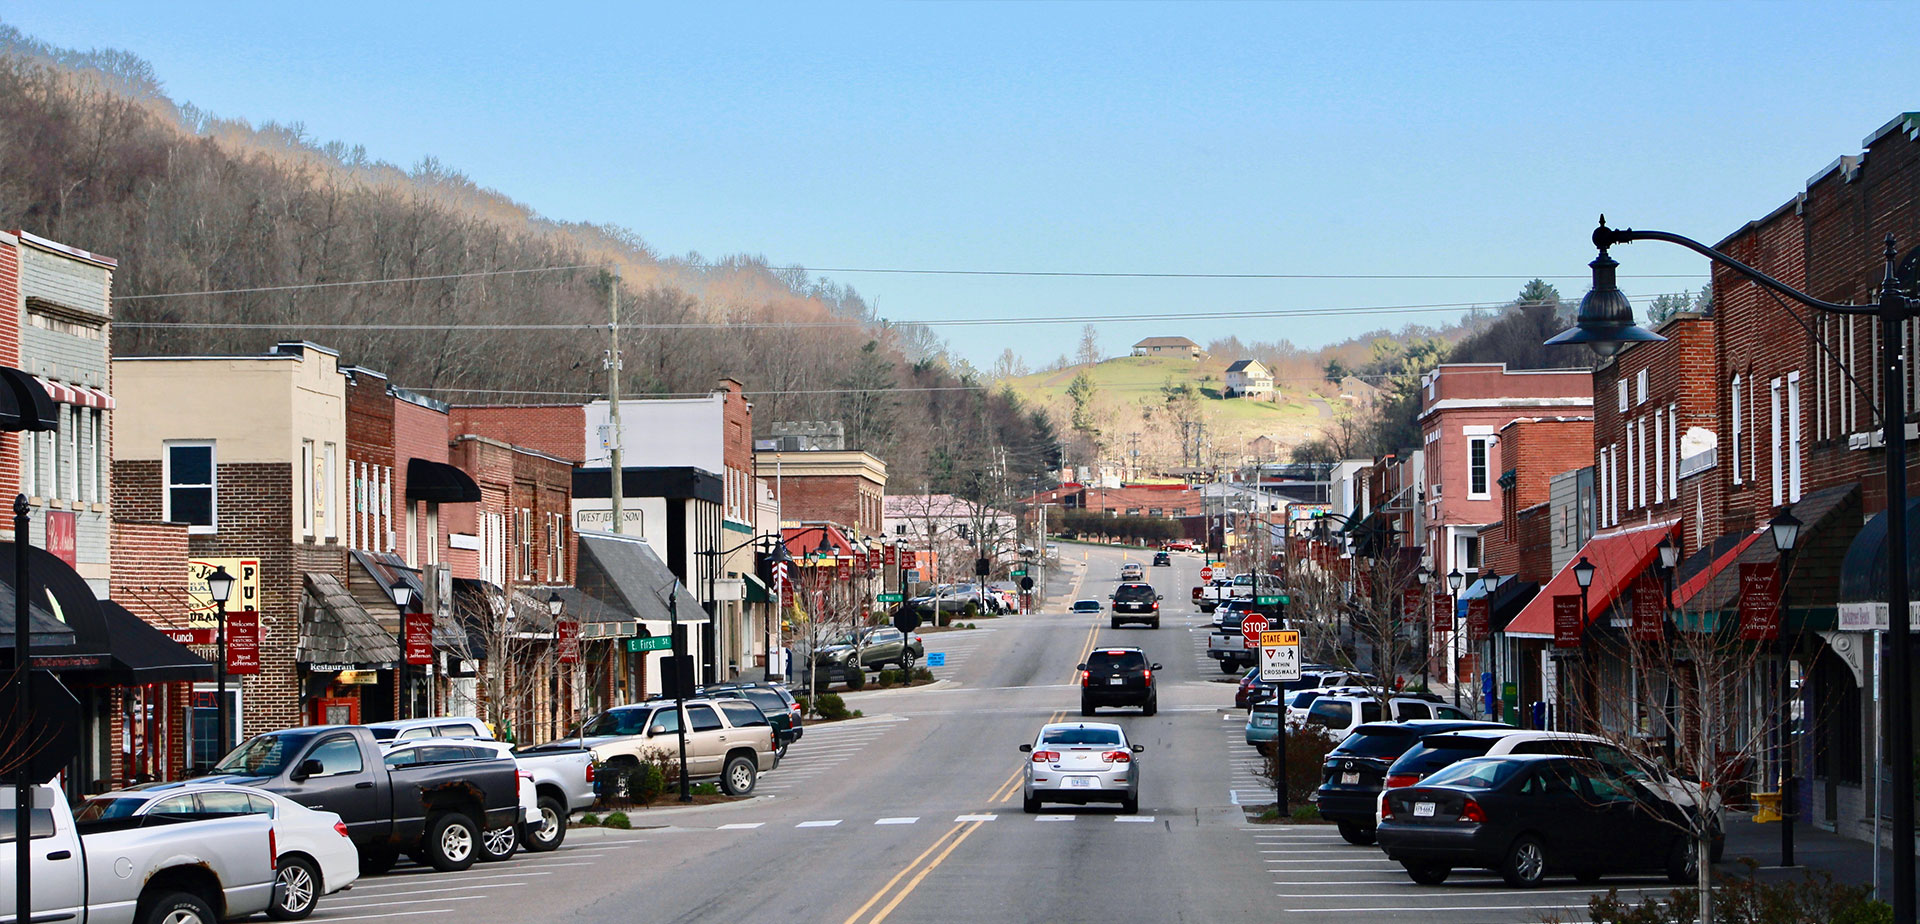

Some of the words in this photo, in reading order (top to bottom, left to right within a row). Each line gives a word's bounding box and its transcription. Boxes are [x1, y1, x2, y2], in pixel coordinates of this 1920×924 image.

[580, 513, 601, 522] WEST
[601, 512, 640, 523] JEFSON
[1243, 622, 1267, 633] STOP
[172, 632, 194, 642] Lunch
[1263, 634, 1281, 643] STATE
[1284, 633, 1297, 643] LAW
[631, 641, 638, 651] E.
[640, 639, 656, 650] First
[230, 659, 258, 667] Jefferson
[310, 663, 355, 671] Restaurant
[193, 692, 218, 708] PEN
